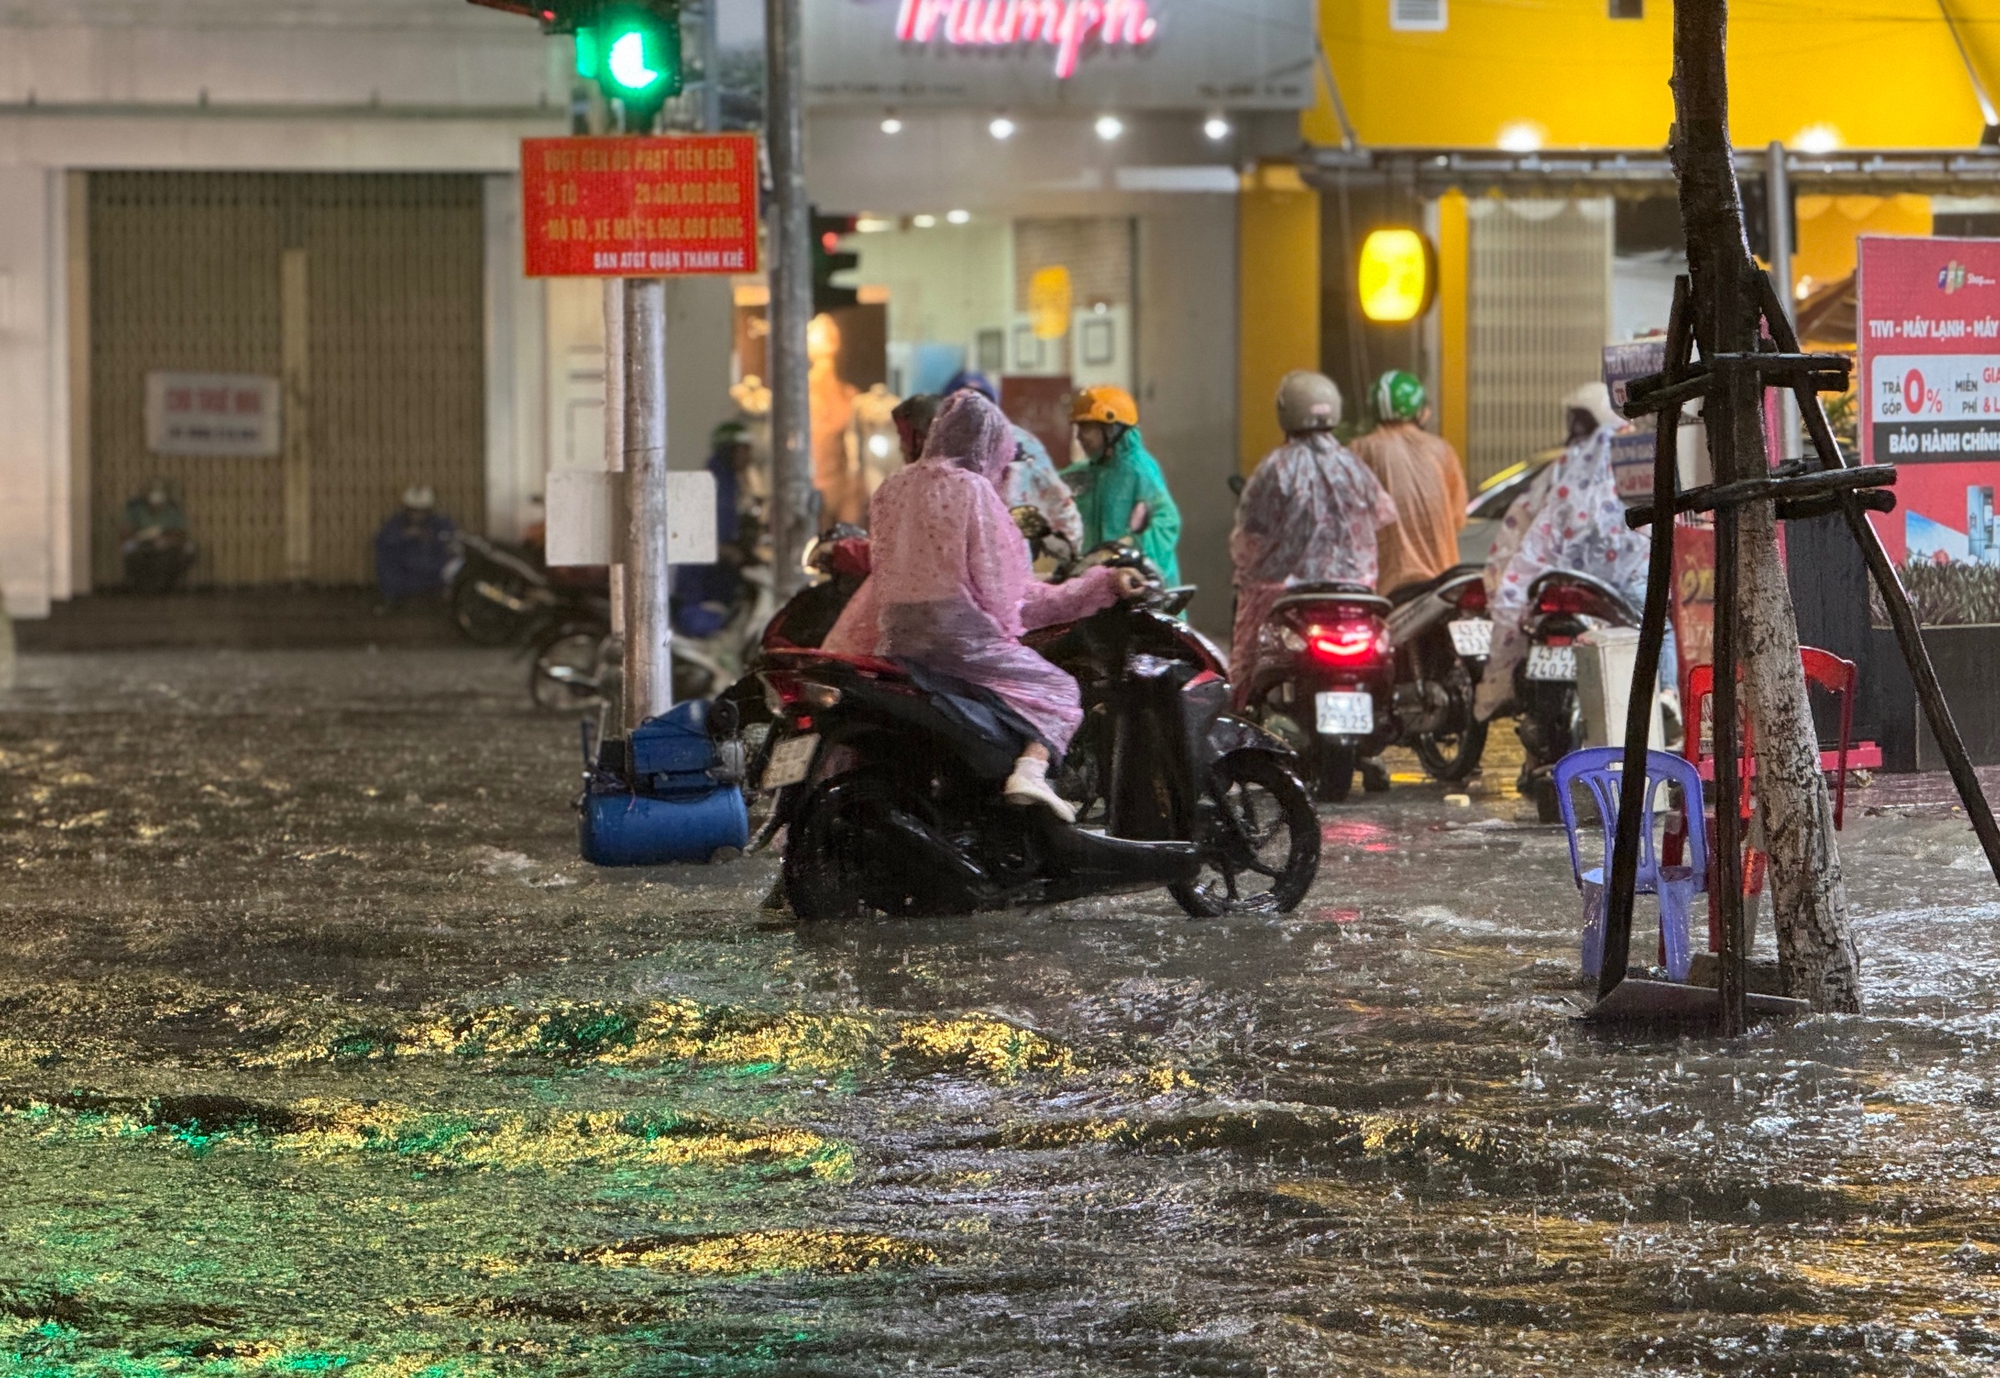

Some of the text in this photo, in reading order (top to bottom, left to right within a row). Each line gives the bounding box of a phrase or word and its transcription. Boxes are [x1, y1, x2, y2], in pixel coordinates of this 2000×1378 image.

[594, 218, 611, 239] XE
[593, 247, 745, 271] BAN ATGT QUẬN THANH KHÊ
[1869, 319, 1894, 338] TIVI
[1903, 315, 1930, 338] MÁY
[1930, 319, 1965, 342] LẠNH
[1973, 314, 2000, 338] MÁY
[1882, 375, 1902, 395] TRẢ
[1882, 398, 1902, 415] GÓP
[1962, 396, 1978, 413] PHÍ
[1889, 426, 2000, 454] BẢO HÀNH CHÍNH
